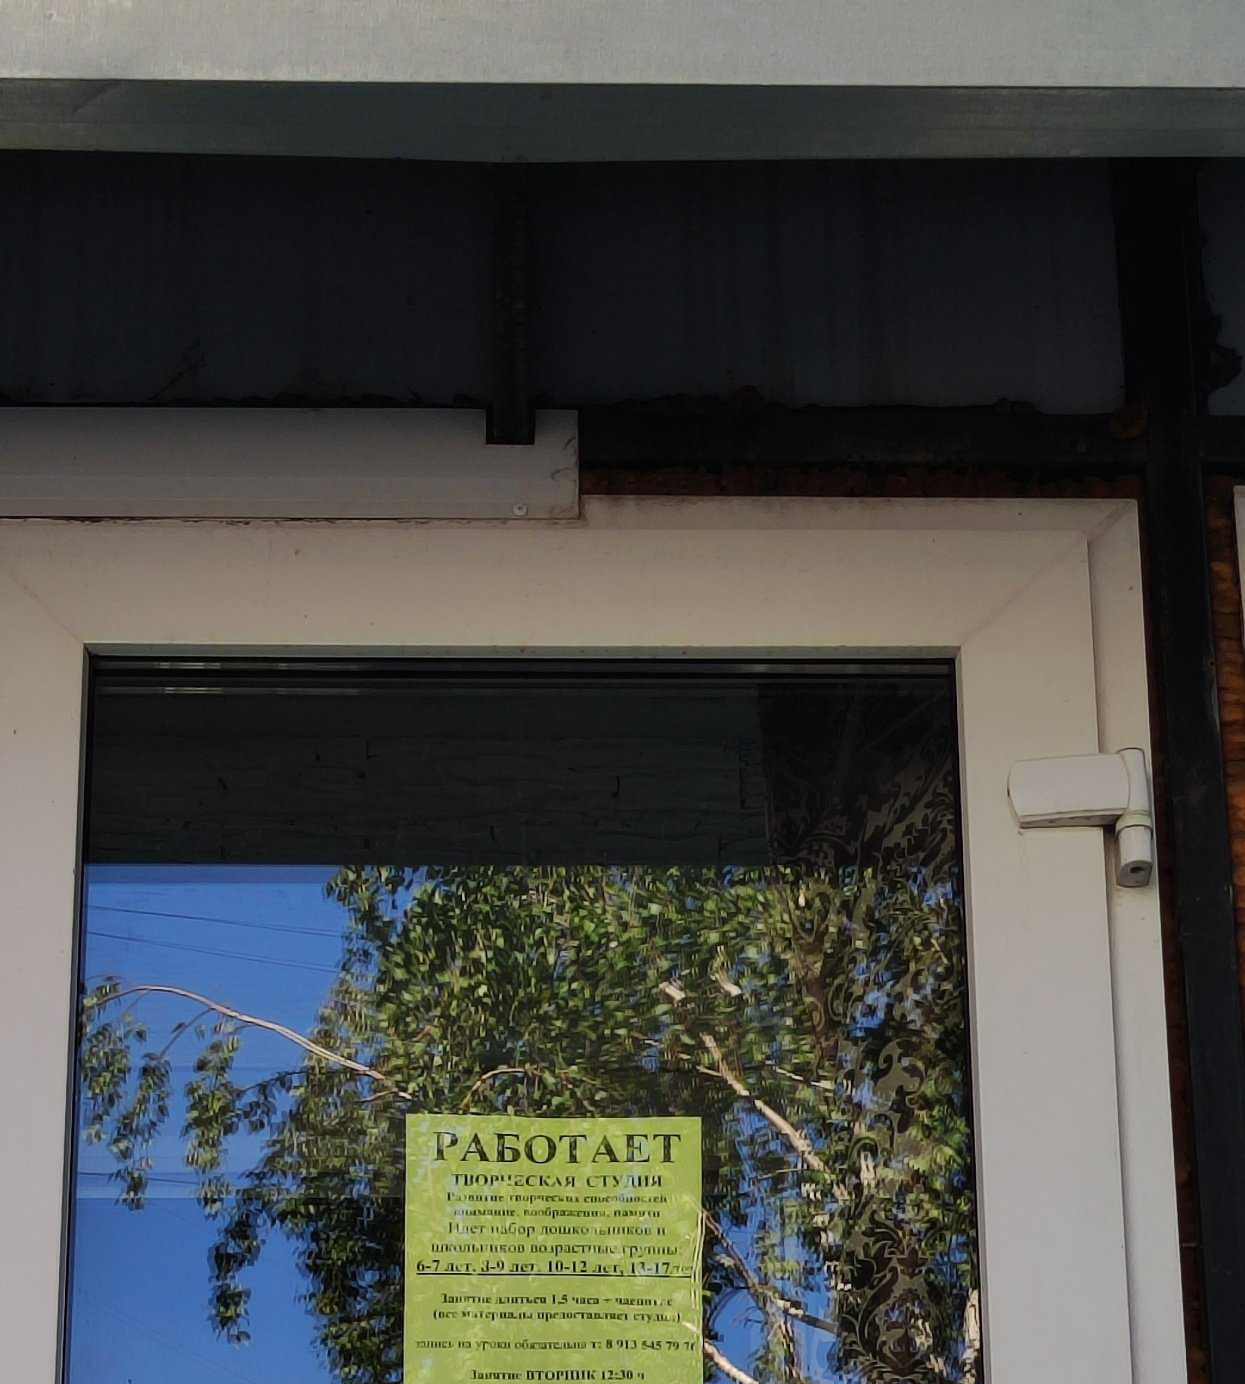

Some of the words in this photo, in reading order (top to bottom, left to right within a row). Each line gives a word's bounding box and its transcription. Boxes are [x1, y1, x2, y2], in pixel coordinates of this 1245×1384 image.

[433, 1131, 682, 1164] РАБОТАЕТ
[451, 1173, 576, 1187] ТВОРЧЕСКАЯ
[586, 1175, 662, 1188] СТУДИЯ
[491, 1222, 536, 1238] набор
[657, 1226, 666, 1236] и
[431, 1243, 525, 1254] школьников
[530, 1244, 617, 1257] возрастные
[416, 1260, 441, 1273] 6-7
[548, 1261, 587, 1274] 10-12
[631, 1262, 670, 1275] 13-17
[441, 1293, 492, 1305] Занятие
[572, 1297, 600, 1305] часа
[458, 1341, 472, 1349] на
[476, 1341, 511, 1352] уроки
[515, 1339, 587, 1350] обязательно
[606, 1340, 613, 1350] 8
[616, 1340, 637, 1350] 913
[641, 1341, 662, 1351] 545
[666, 1341, 680, 1351] 79
[471, 1370, 521, 1380] Занятие
[526, 1370, 596, 1381] ВТОРНИК
[600, 1370, 634, 1381] 12:30
